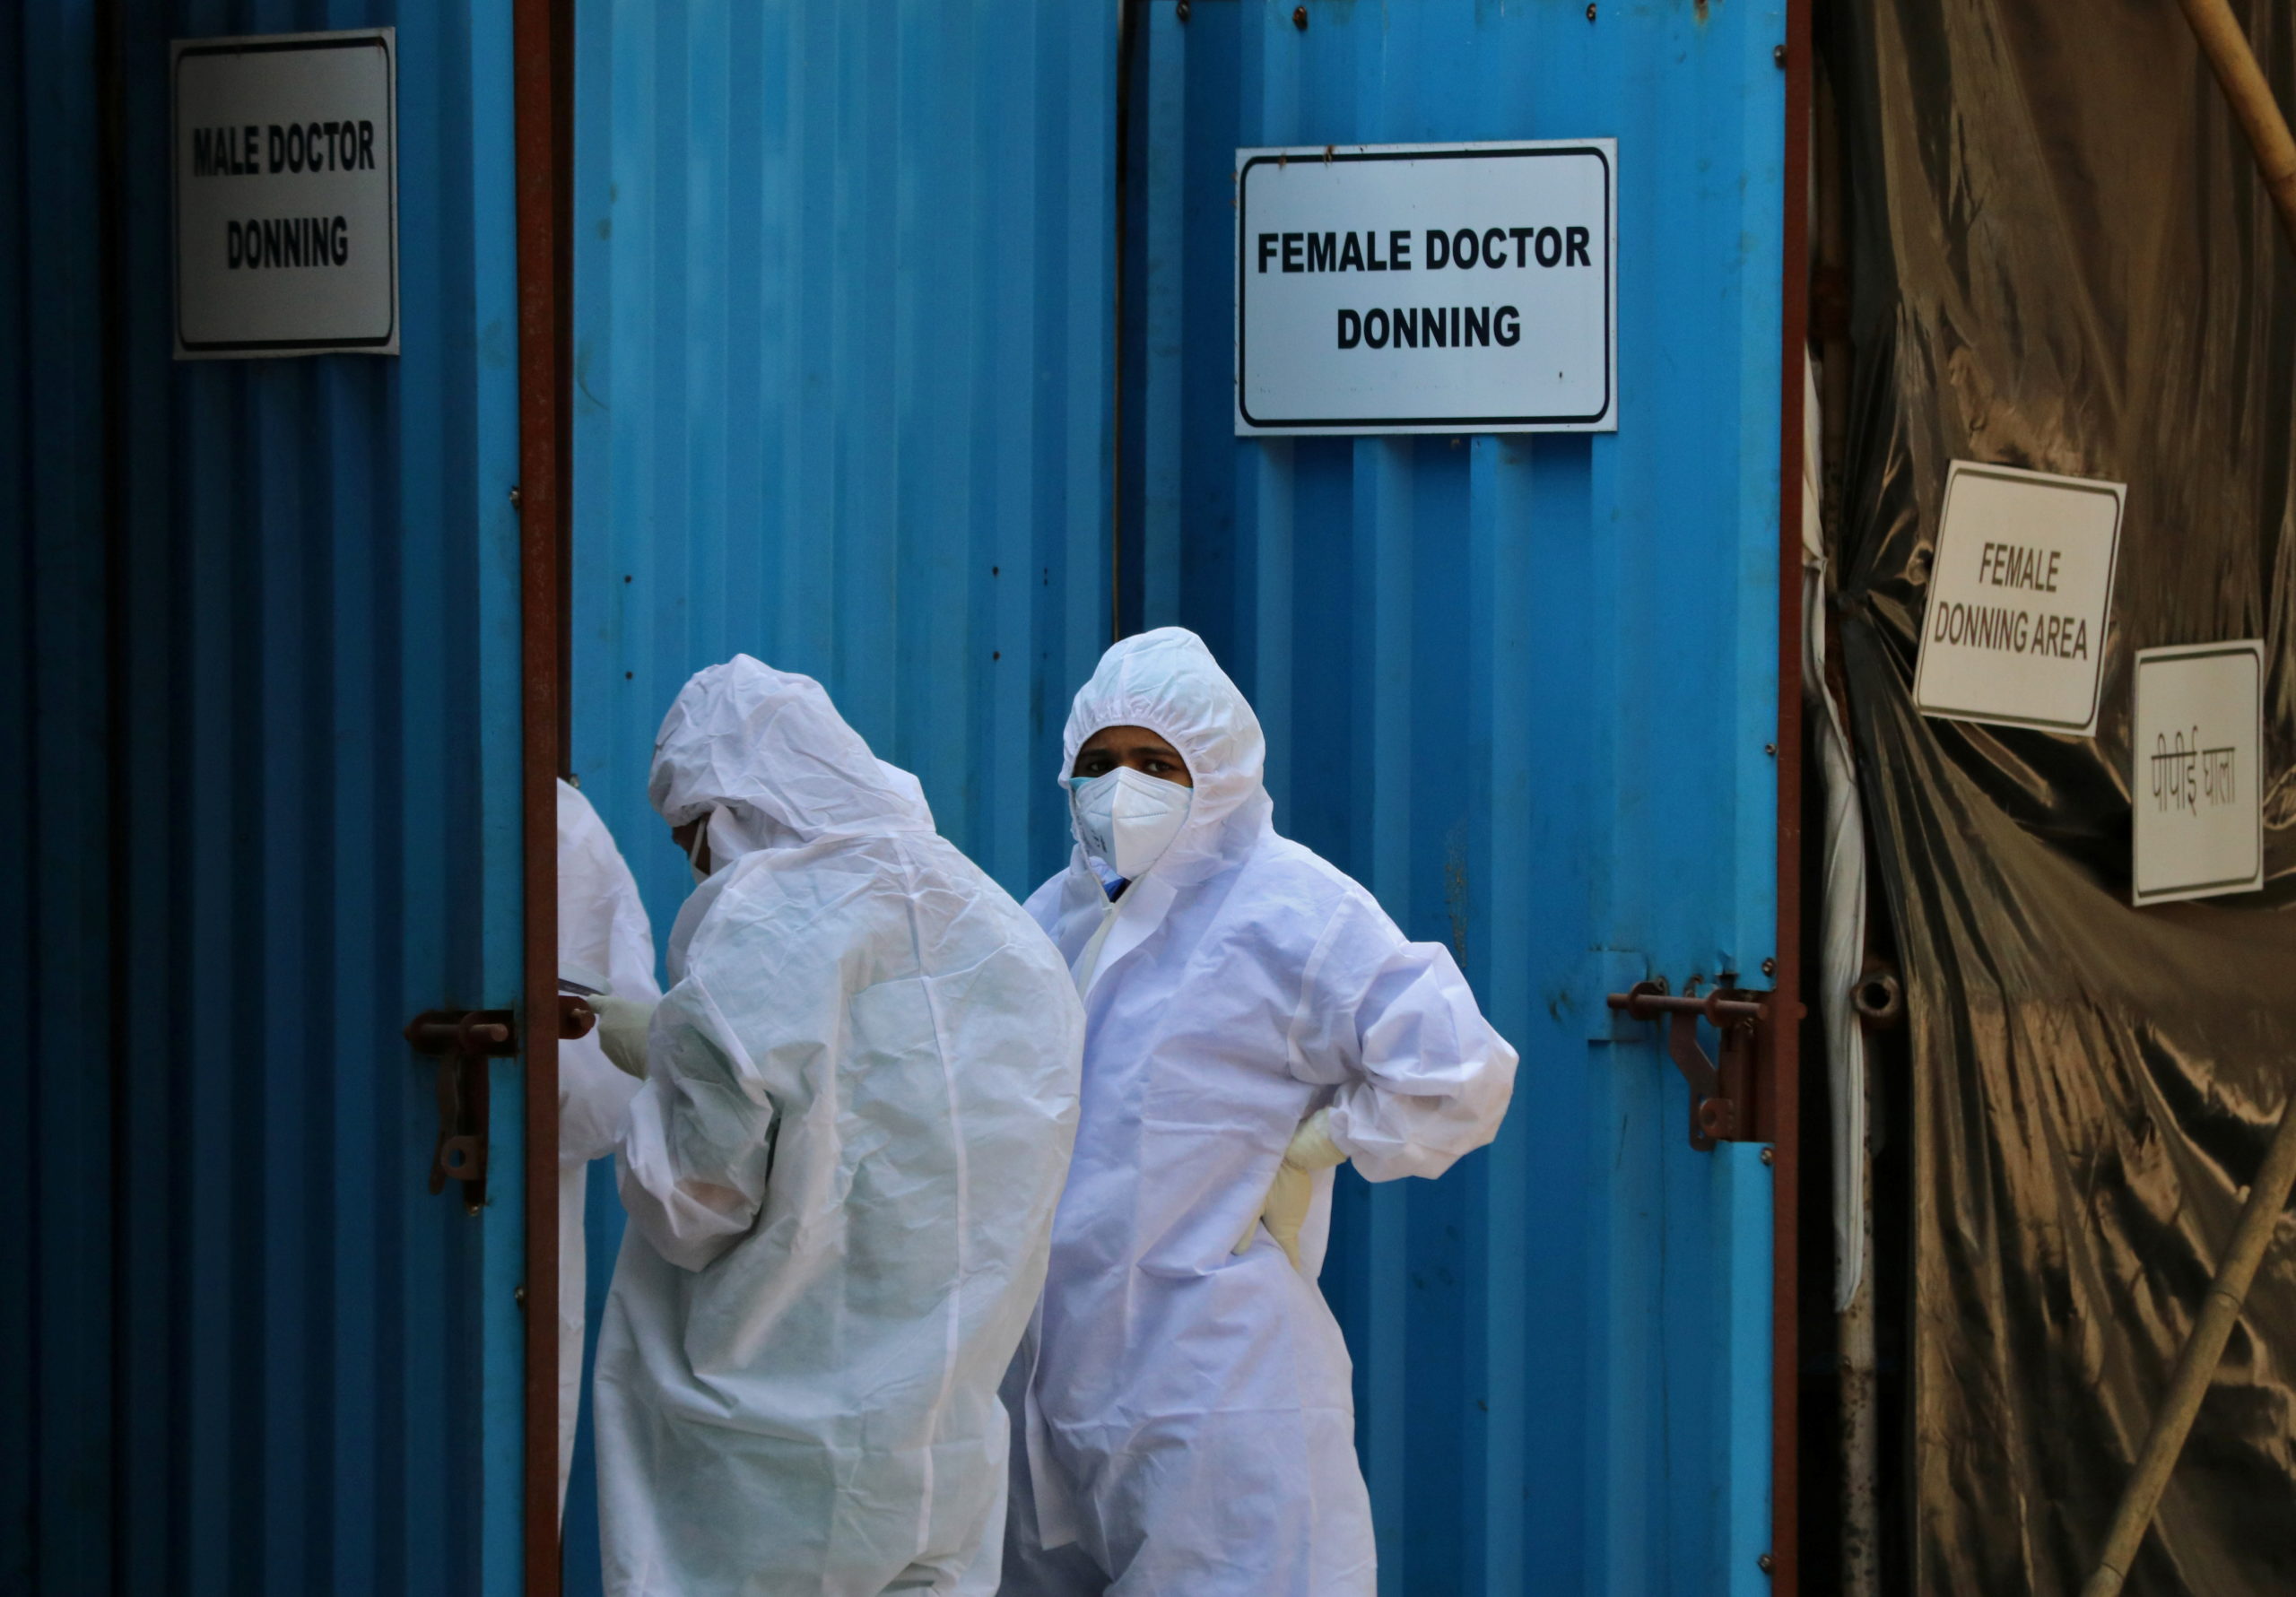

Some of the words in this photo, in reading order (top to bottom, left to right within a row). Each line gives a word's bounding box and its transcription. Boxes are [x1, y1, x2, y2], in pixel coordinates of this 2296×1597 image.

[193, 126, 259, 176] MALE
[268, 120, 375, 174] DOCTOR
[227, 215, 348, 269] DONNING
[1257, 230, 1412, 273] FEMALE
[1426, 226, 1592, 271] DOCTOR
[1337, 305, 1521, 350] DONNING
[1979, 542, 2061, 593] FEMALE
[1934, 601, 2029, 654] DONNING
[2031, 613, 2088, 661] AREA
[2151, 725, 2198, 816] पीपीई
[2202, 747, 2236, 804] घाला
